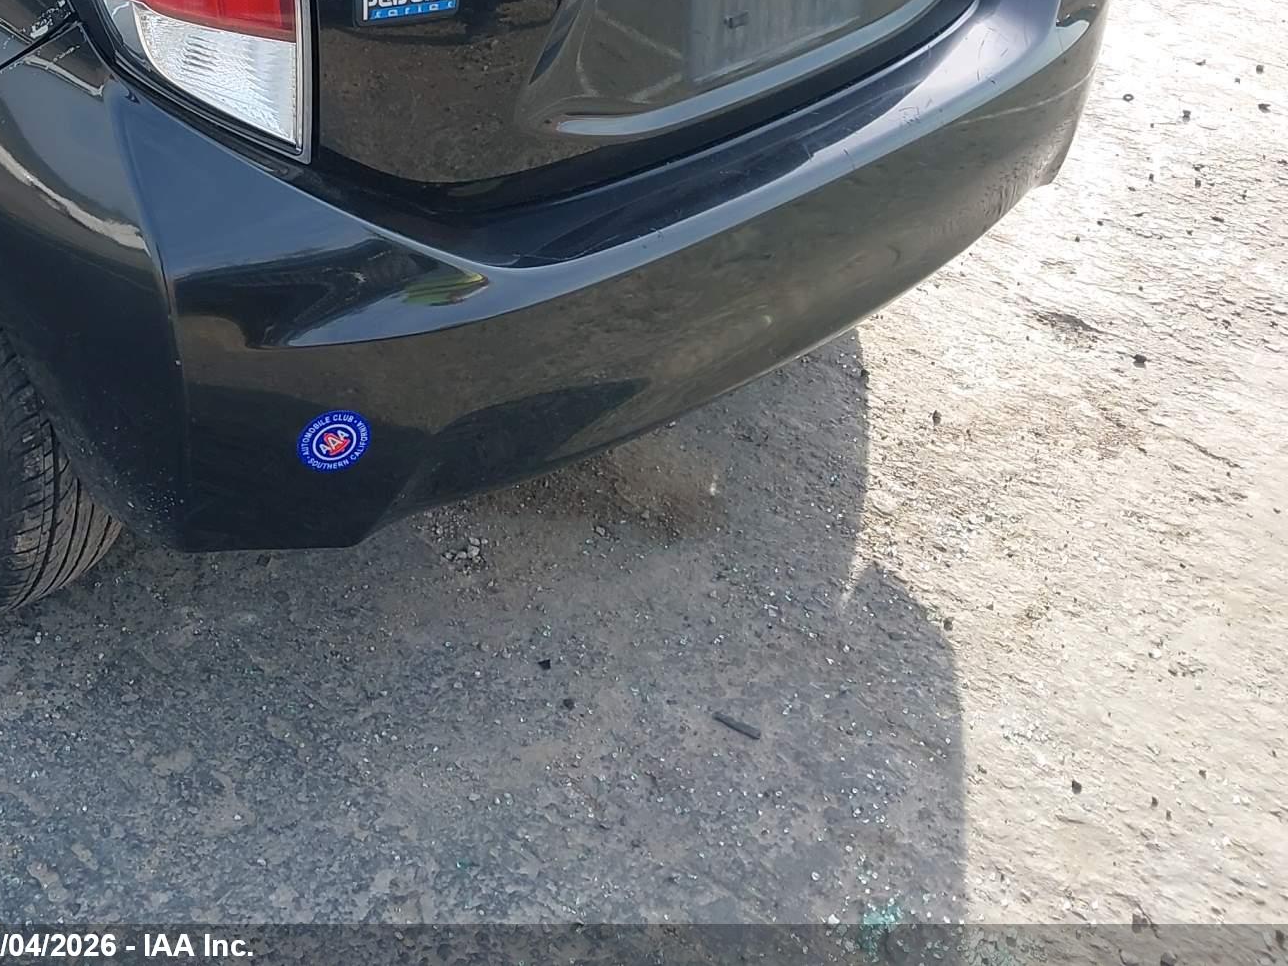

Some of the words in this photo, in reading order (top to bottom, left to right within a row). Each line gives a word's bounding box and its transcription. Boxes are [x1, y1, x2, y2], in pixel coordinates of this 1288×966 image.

[301, 416, 331, 455] AUTOMOBILE
[332, 414, 354, 422] CLUB
[308, 458, 349, 469] SOUTHERN
[350, 421, 368, 460] CALIFORNIA
[319, 430, 350, 455] AAA
